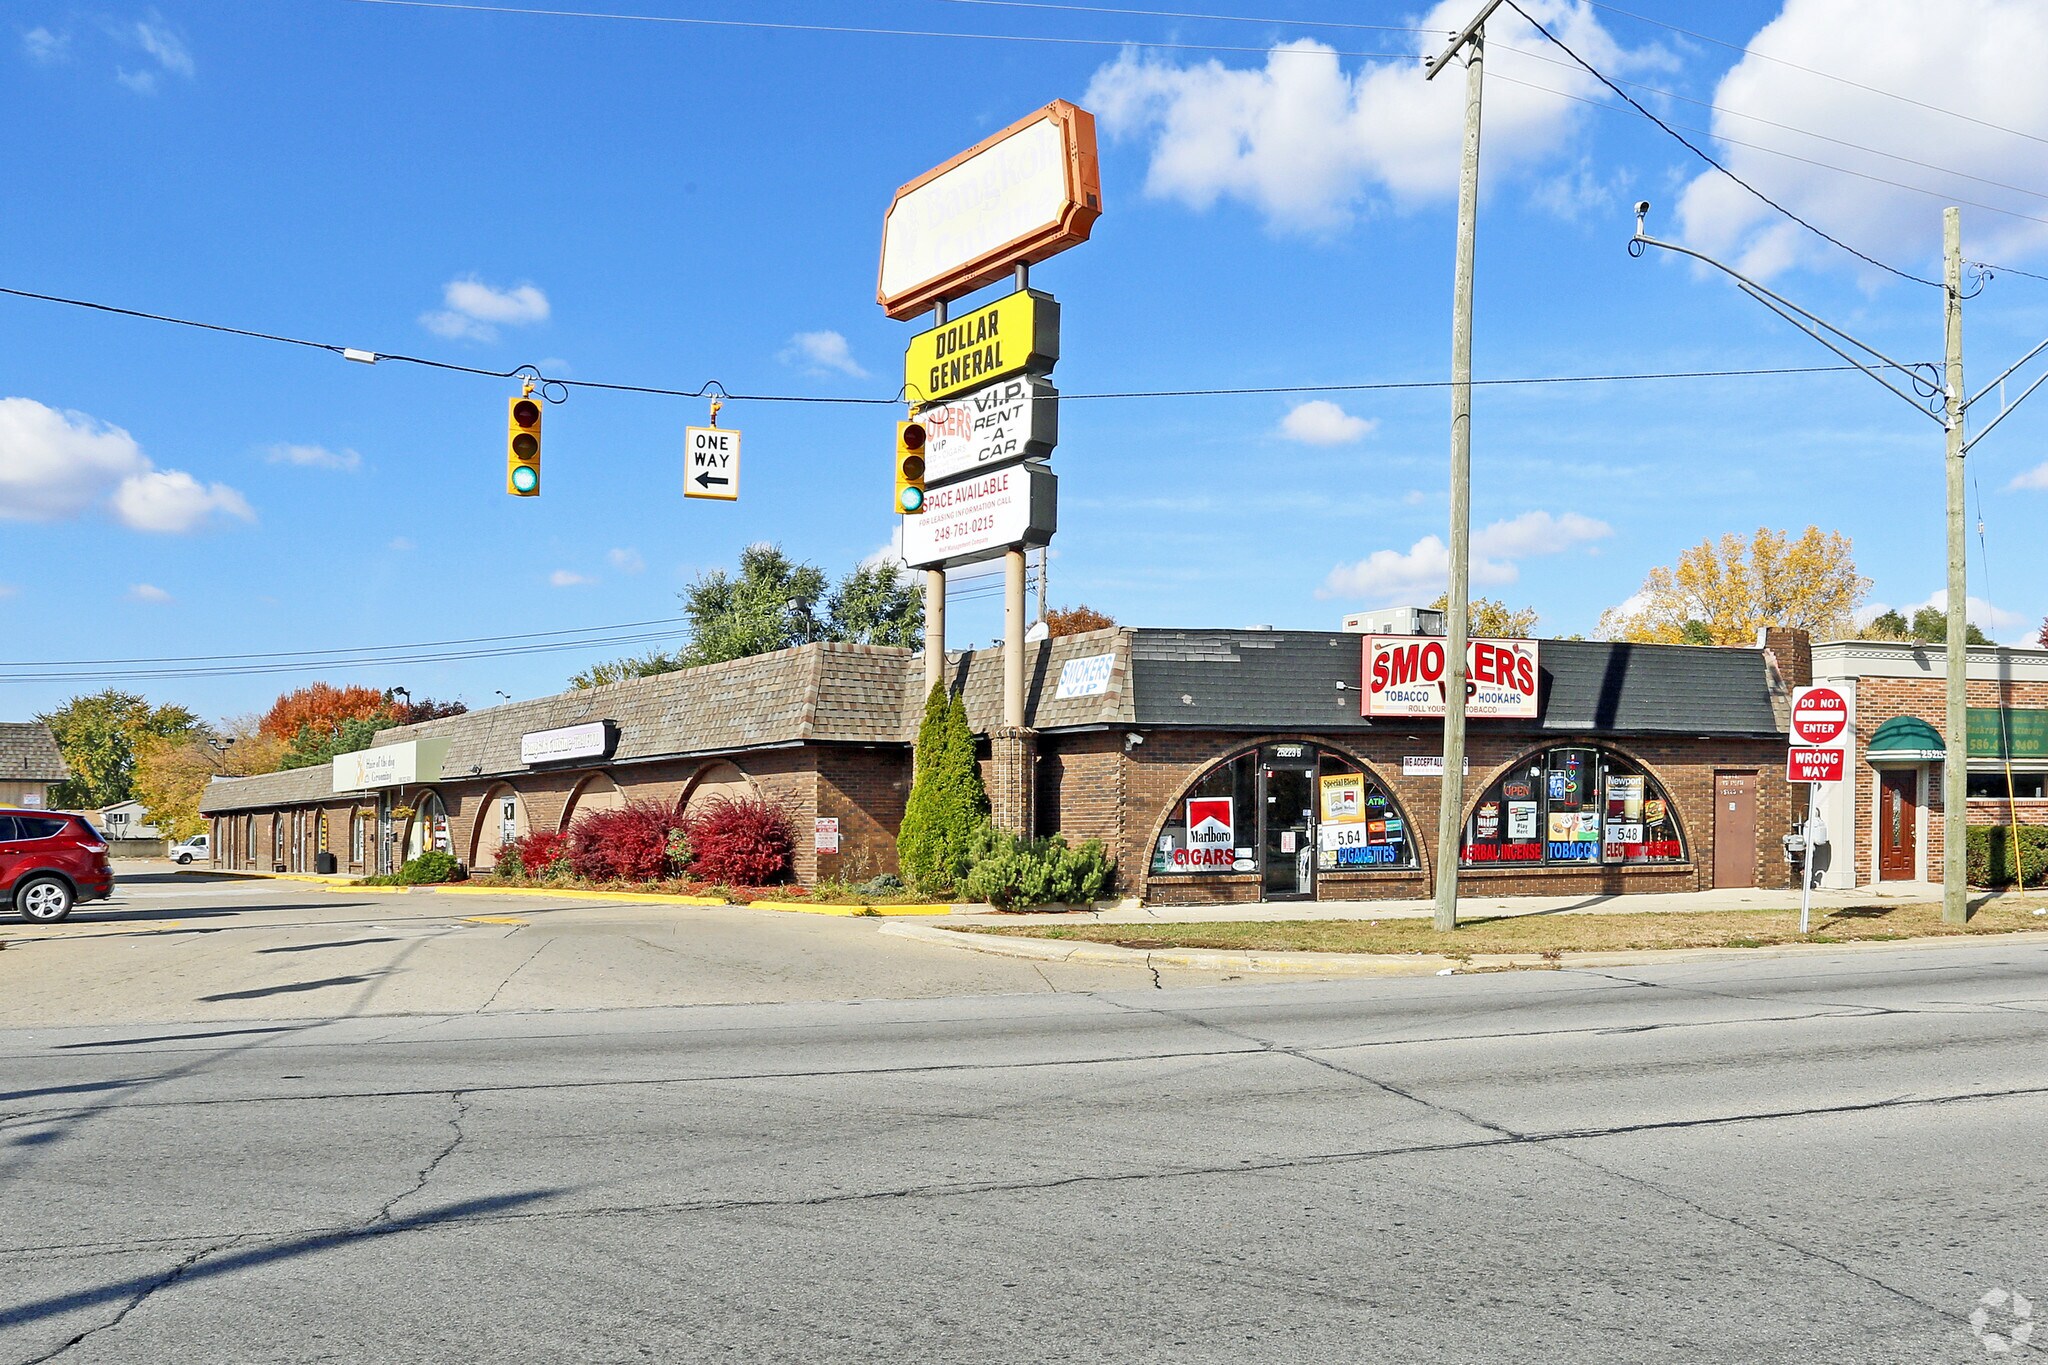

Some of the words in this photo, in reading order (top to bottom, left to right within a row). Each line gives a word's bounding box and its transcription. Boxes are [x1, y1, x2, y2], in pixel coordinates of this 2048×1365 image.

[936, 310, 998, 360] DOLLAR
[930, 341, 1003, 394] GENERAL
[973, 404, 1024, 431] RENT
[696, 434, 728, 450] ONE
[932, 439, 947, 452] VIP
[978, 439, 1016, 461] CAR
[694, 452, 729, 468] WAY
[923, 490, 953, 513] SPACE
[955, 474, 1009, 504] AVAILABLE
[919, 518, 930, 527] FOR
[931, 511, 955, 525] LEASING
[955, 500, 996, 518] INFORMATION
[997, 496, 1012, 506] CALL
[934, 515, 994, 542] 248-761-0215
[971, 537, 989, 547] Company
[1060, 656, 1112, 685] SMOKERS
[1066, 683, 1098, 695] VIP
[1384, 690, 1429, 702] TOBACCO
[1478, 692, 1522, 704] HOOKAHS
[1408, 705, 1426, 713] ROLL
[1427, 704, 1446, 713] YOUR
[1801, 698, 1815, 709] DO
[1820, 698, 1841, 709] NOT
[1802, 723, 1835, 734] ENTER
[1414, 758, 1433, 767] ACCEPT
[1795, 752, 1839, 765] WRONG
[1802, 766, 1829, 778] WAY
[1323, 778, 1343, 789] Special
[1343, 777, 1359, 787] Blend
[1608, 776, 1642, 786] Newport
[1503, 785, 1530, 796] OPEN
[1367, 797, 1386, 807] ATM
[1190, 826, 1231, 843] Marlboro
[1337, 830, 1361, 846] 5.64
[1173, 847, 1235, 866] CIGARS
[1338, 845, 1396, 864] CIGARETTES
[1501, 843, 1543, 861] INCENSE
[1548, 842, 1600, 859] TOBACCO
